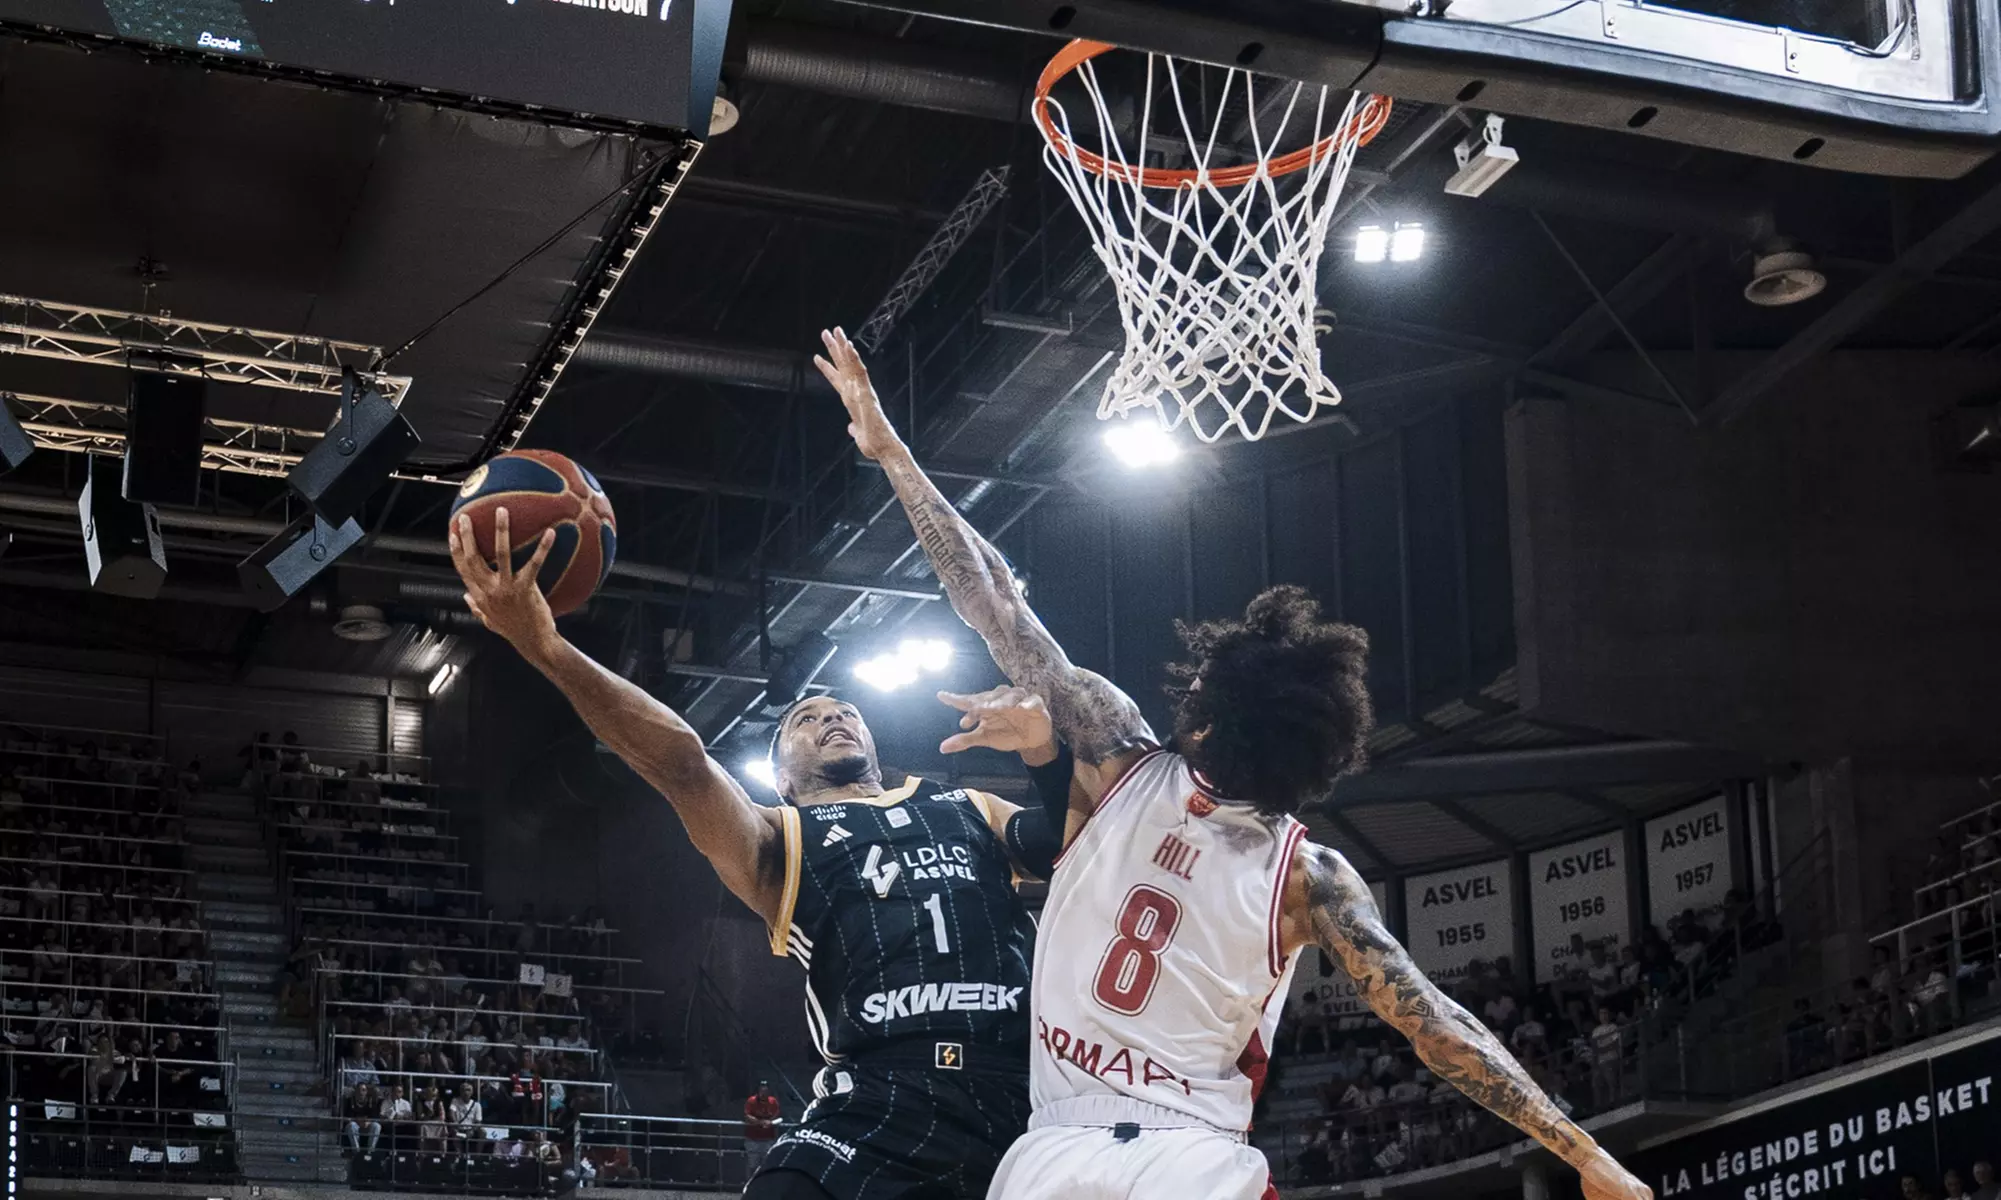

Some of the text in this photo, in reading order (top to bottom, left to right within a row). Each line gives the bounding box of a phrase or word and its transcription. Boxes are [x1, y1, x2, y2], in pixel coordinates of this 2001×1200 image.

[198, 32, 241, 51] Bodet
[1661, 812, 1724, 852] ASVEL
[903, 843, 969, 868] LDLC
[1152, 832, 1201, 883] HILL
[1545, 847, 1616, 884] ASVEL
[913, 864, 976, 881] ASVEL
[1675, 862, 1714, 892] 1957
[1422, 876, 1498, 908] ASVEL
[923, 893, 949, 953] 1
[1559, 896, 1606, 923] 1956
[1092, 883, 1183, 1017] 8
[1437, 923, 1486, 947] 1955
[860, 982, 1024, 1023] SKWEEK
[1320, 983, 1358, 999] DLC
[1662, 1077, 1992, 1197] LA LÉGENDE DU BASKET
[1858, 1146, 1897, 1179] ICI
